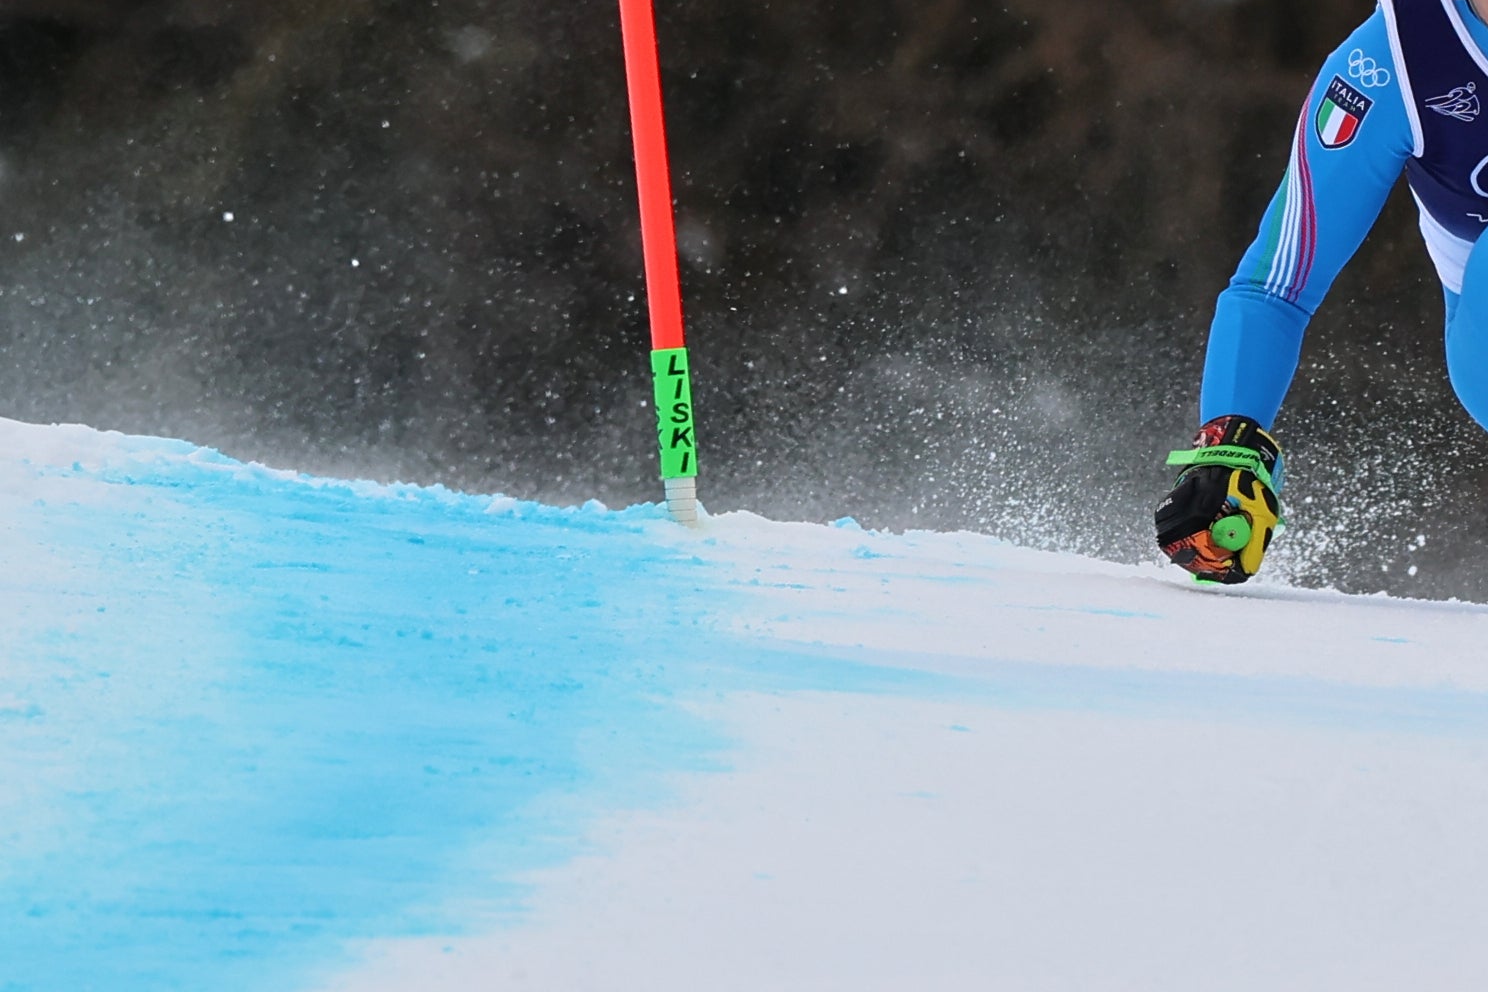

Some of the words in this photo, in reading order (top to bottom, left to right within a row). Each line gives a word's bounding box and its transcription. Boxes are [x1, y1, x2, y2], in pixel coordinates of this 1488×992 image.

[1331, 80, 1366, 111] ITALIA
[1333, 93, 1357, 112] TEAM
[667, 354, 692, 474] LISKI
